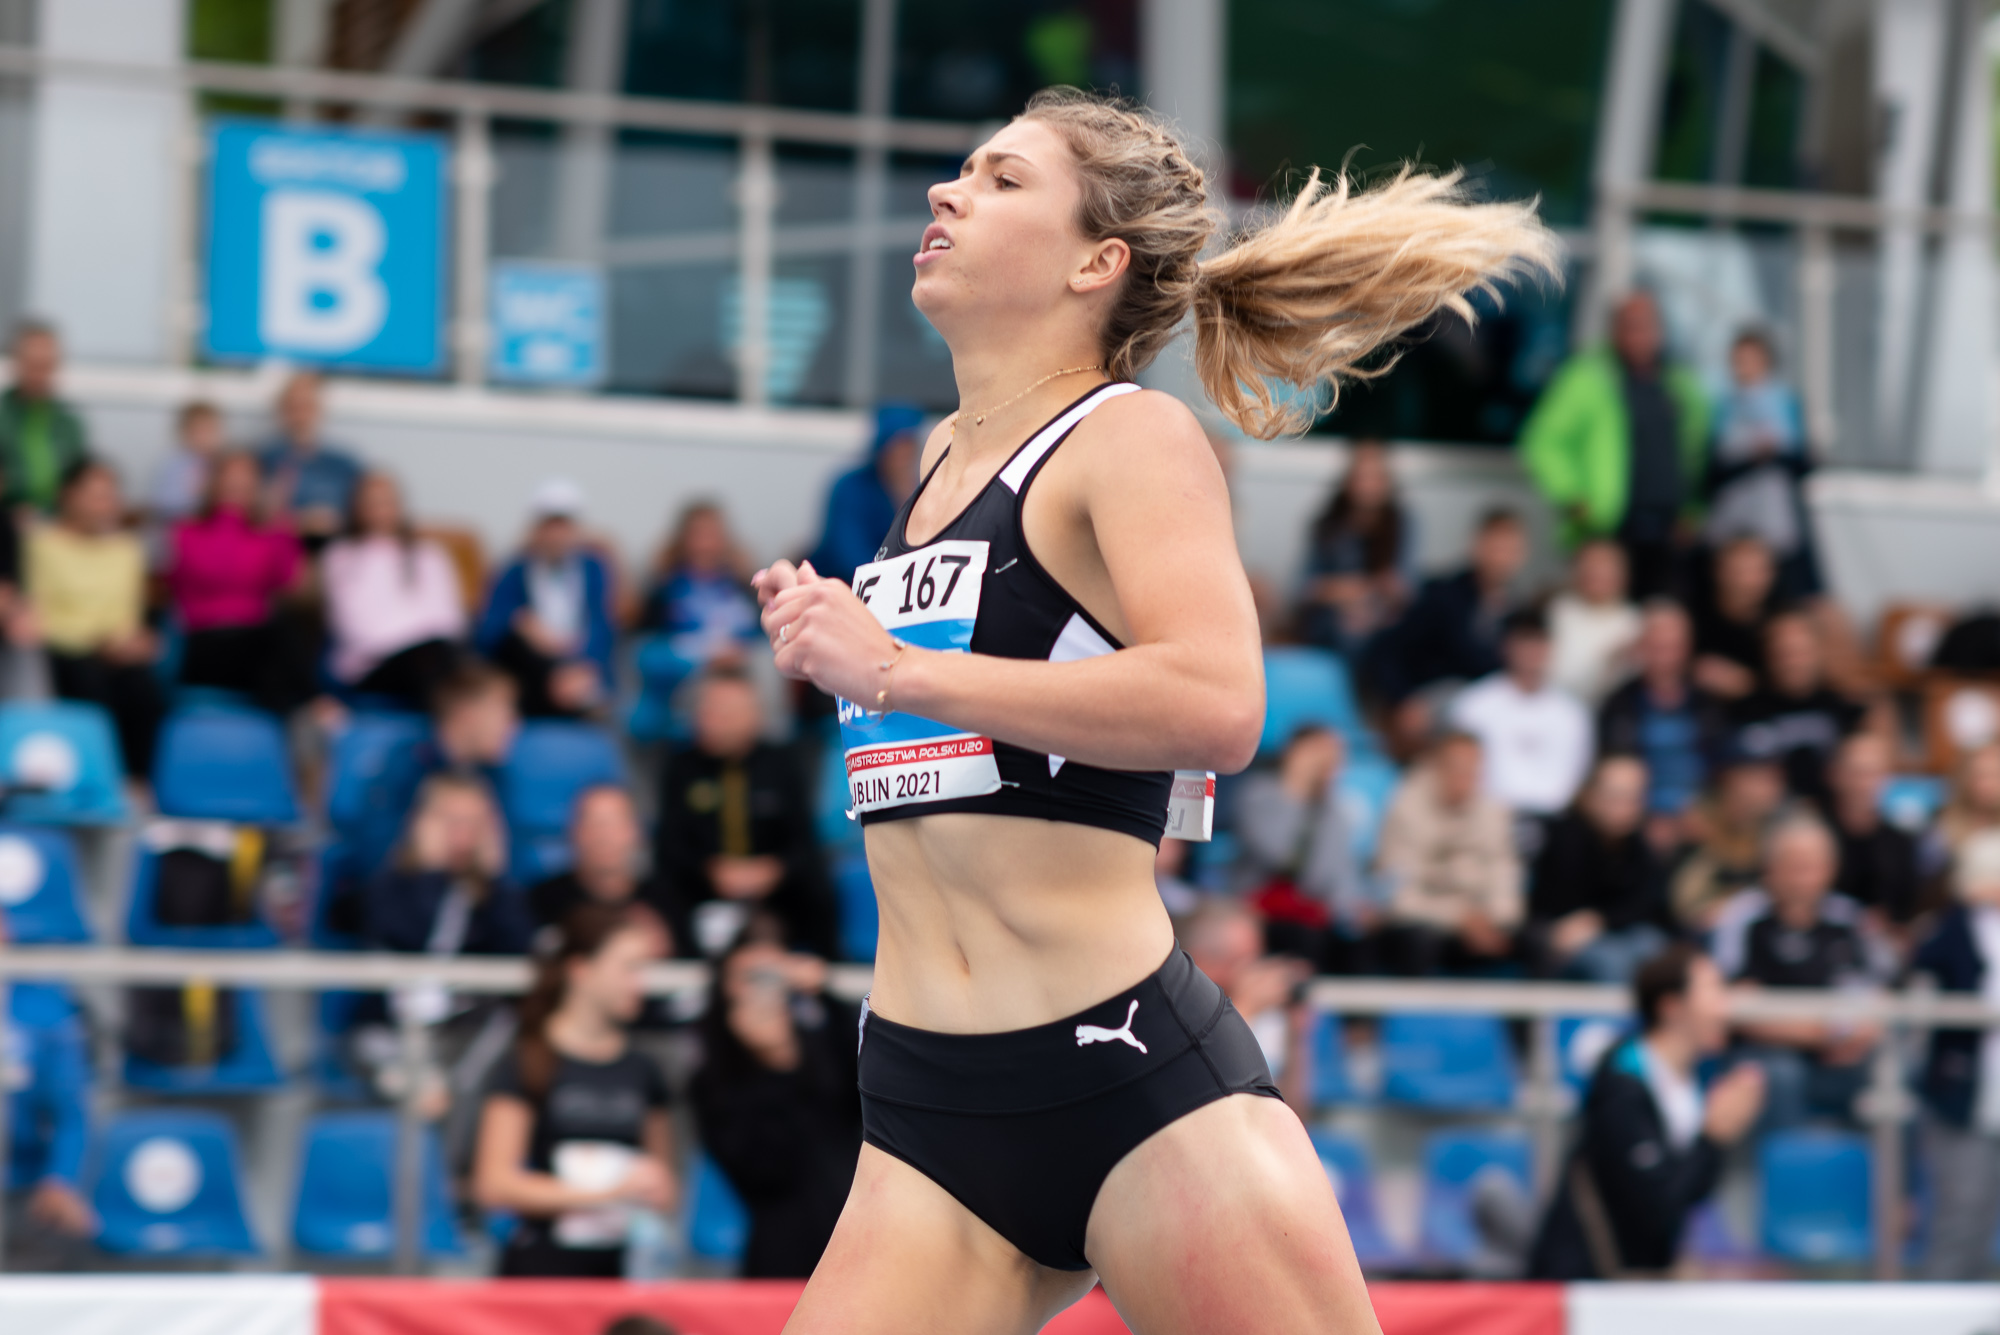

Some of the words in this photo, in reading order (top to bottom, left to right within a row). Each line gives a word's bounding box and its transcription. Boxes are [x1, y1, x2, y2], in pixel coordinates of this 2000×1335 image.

[261, 190, 388, 351] B
[898, 554, 972, 615] 167
[918, 743, 958, 760] POLSKI
[959, 740, 984, 754] U20
[896, 770, 940, 799] 2021
